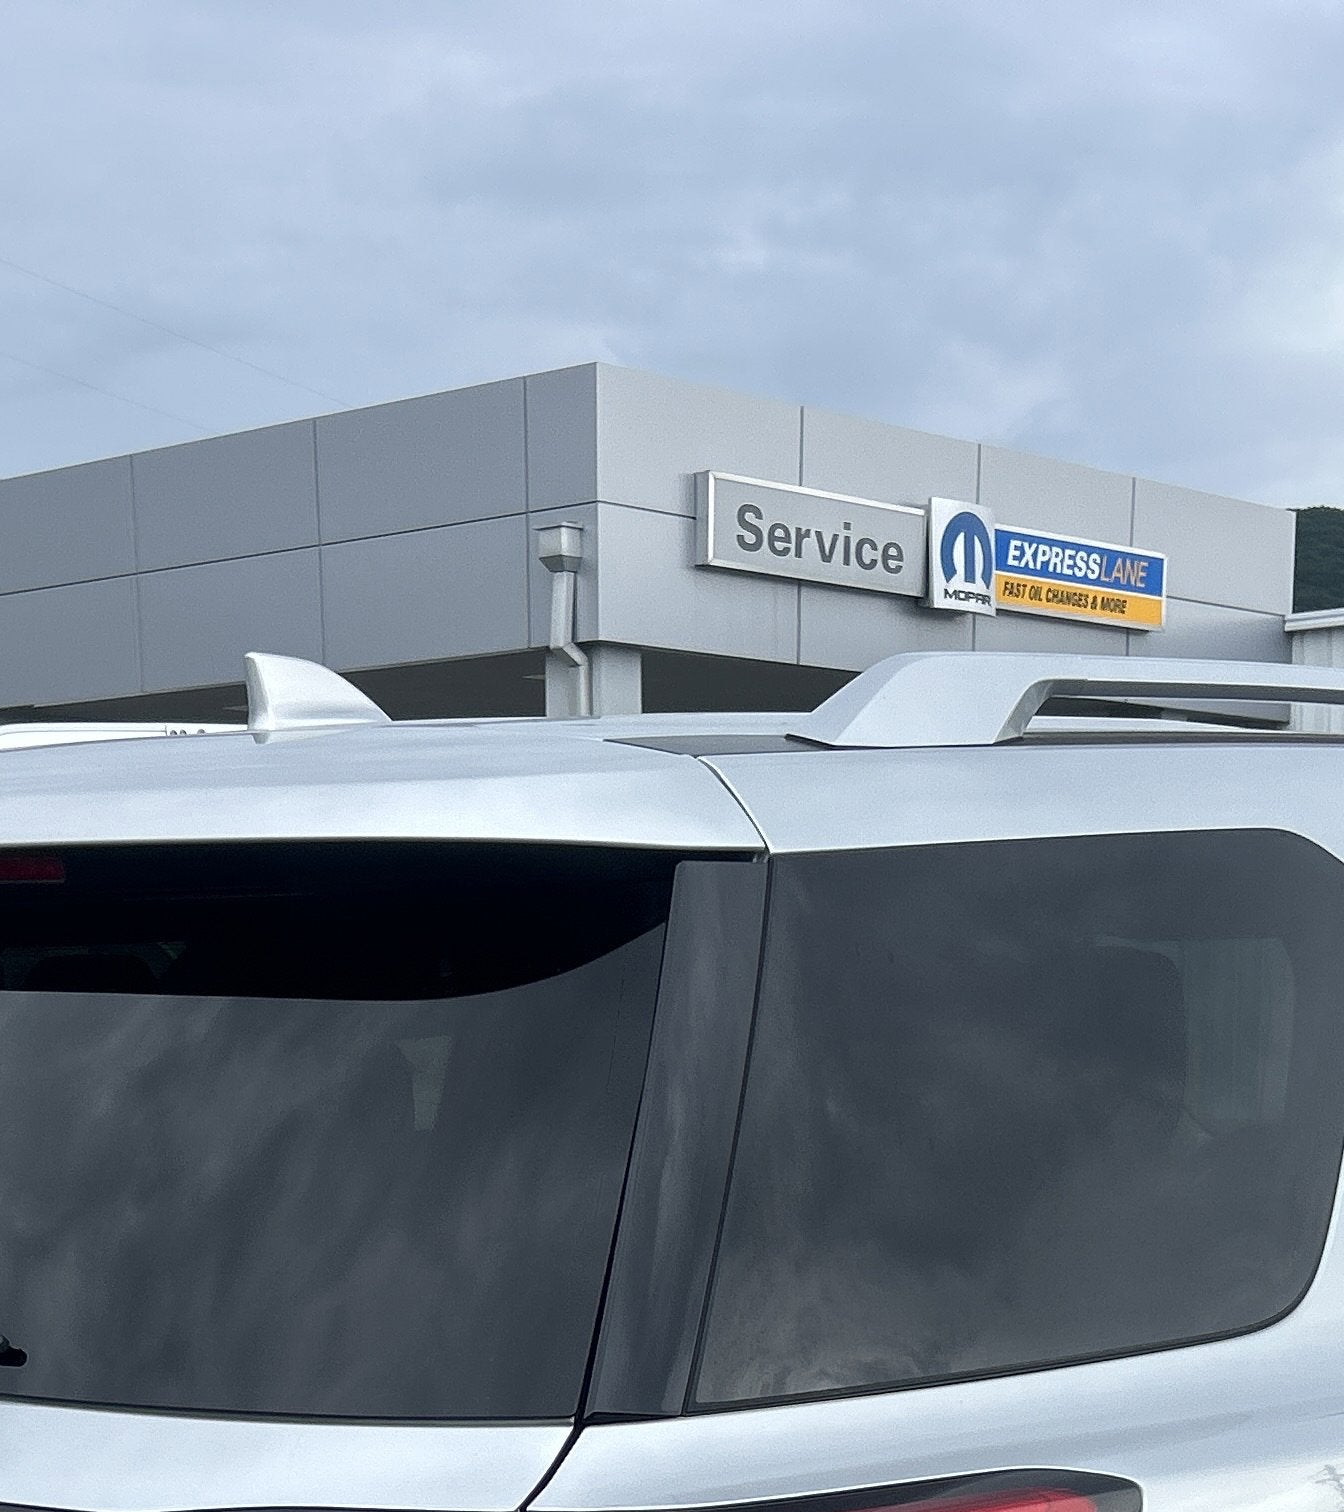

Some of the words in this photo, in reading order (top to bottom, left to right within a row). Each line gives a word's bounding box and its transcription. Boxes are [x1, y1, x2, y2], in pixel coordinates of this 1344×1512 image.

[736, 503, 904, 575] Service
[943, 588, 992, 607] MOPAR
[1002, 581, 1027, 600] FAST
[1028, 585, 1043, 601] OIL
[1045, 587, 1089, 610] CHANGES
[1099, 597, 1128, 614] MORE
